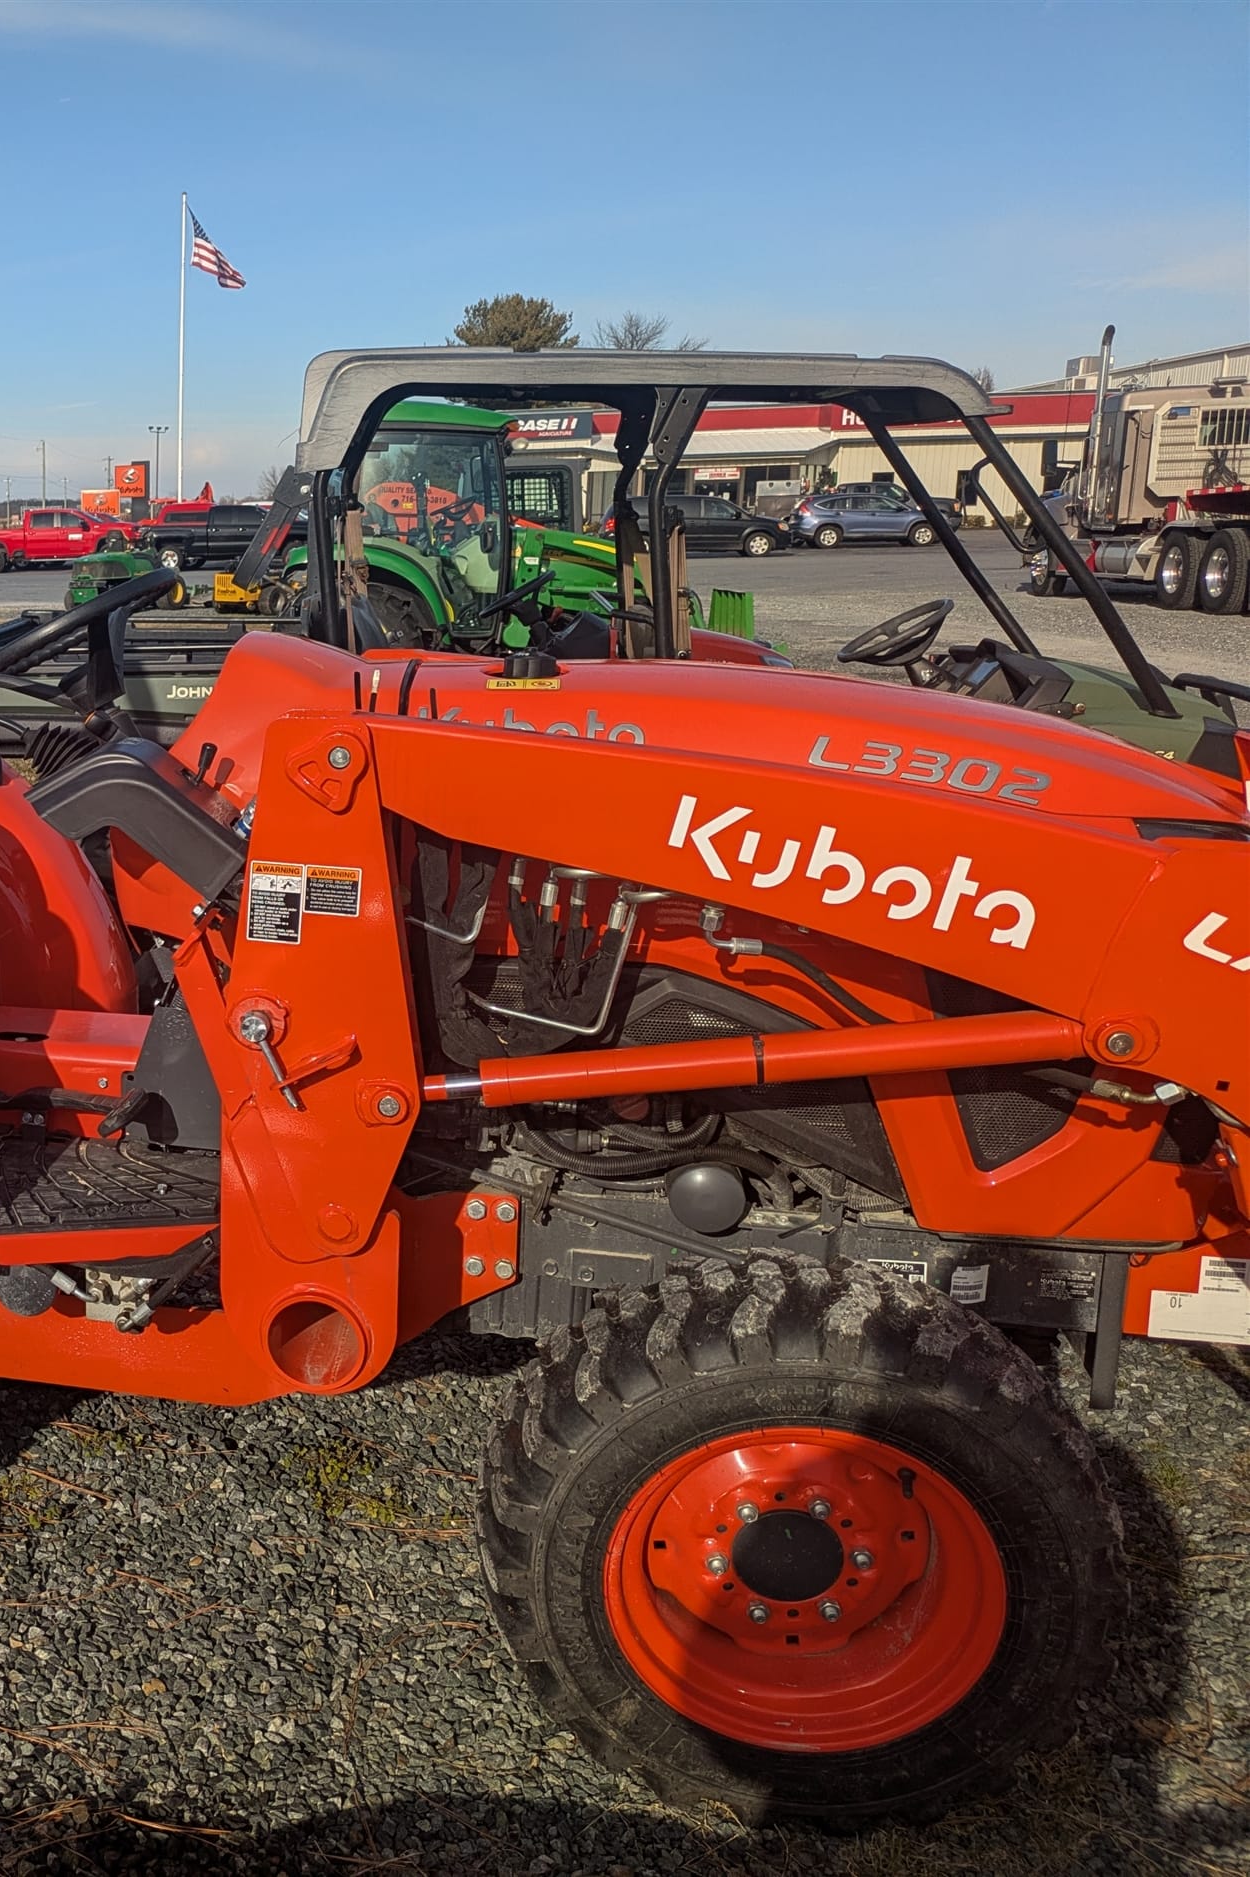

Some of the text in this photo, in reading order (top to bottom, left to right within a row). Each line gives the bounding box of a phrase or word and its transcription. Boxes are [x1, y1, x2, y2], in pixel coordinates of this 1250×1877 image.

[166, 684, 213, 699] JOHN
[808, 735, 1052, 805] L3302
[262, 865, 300, 875] WARNING
[317, 869, 356, 879] WARNING
[667, 794, 1036, 949] Kubota
[881, 1262, 914, 1271] Kubota
